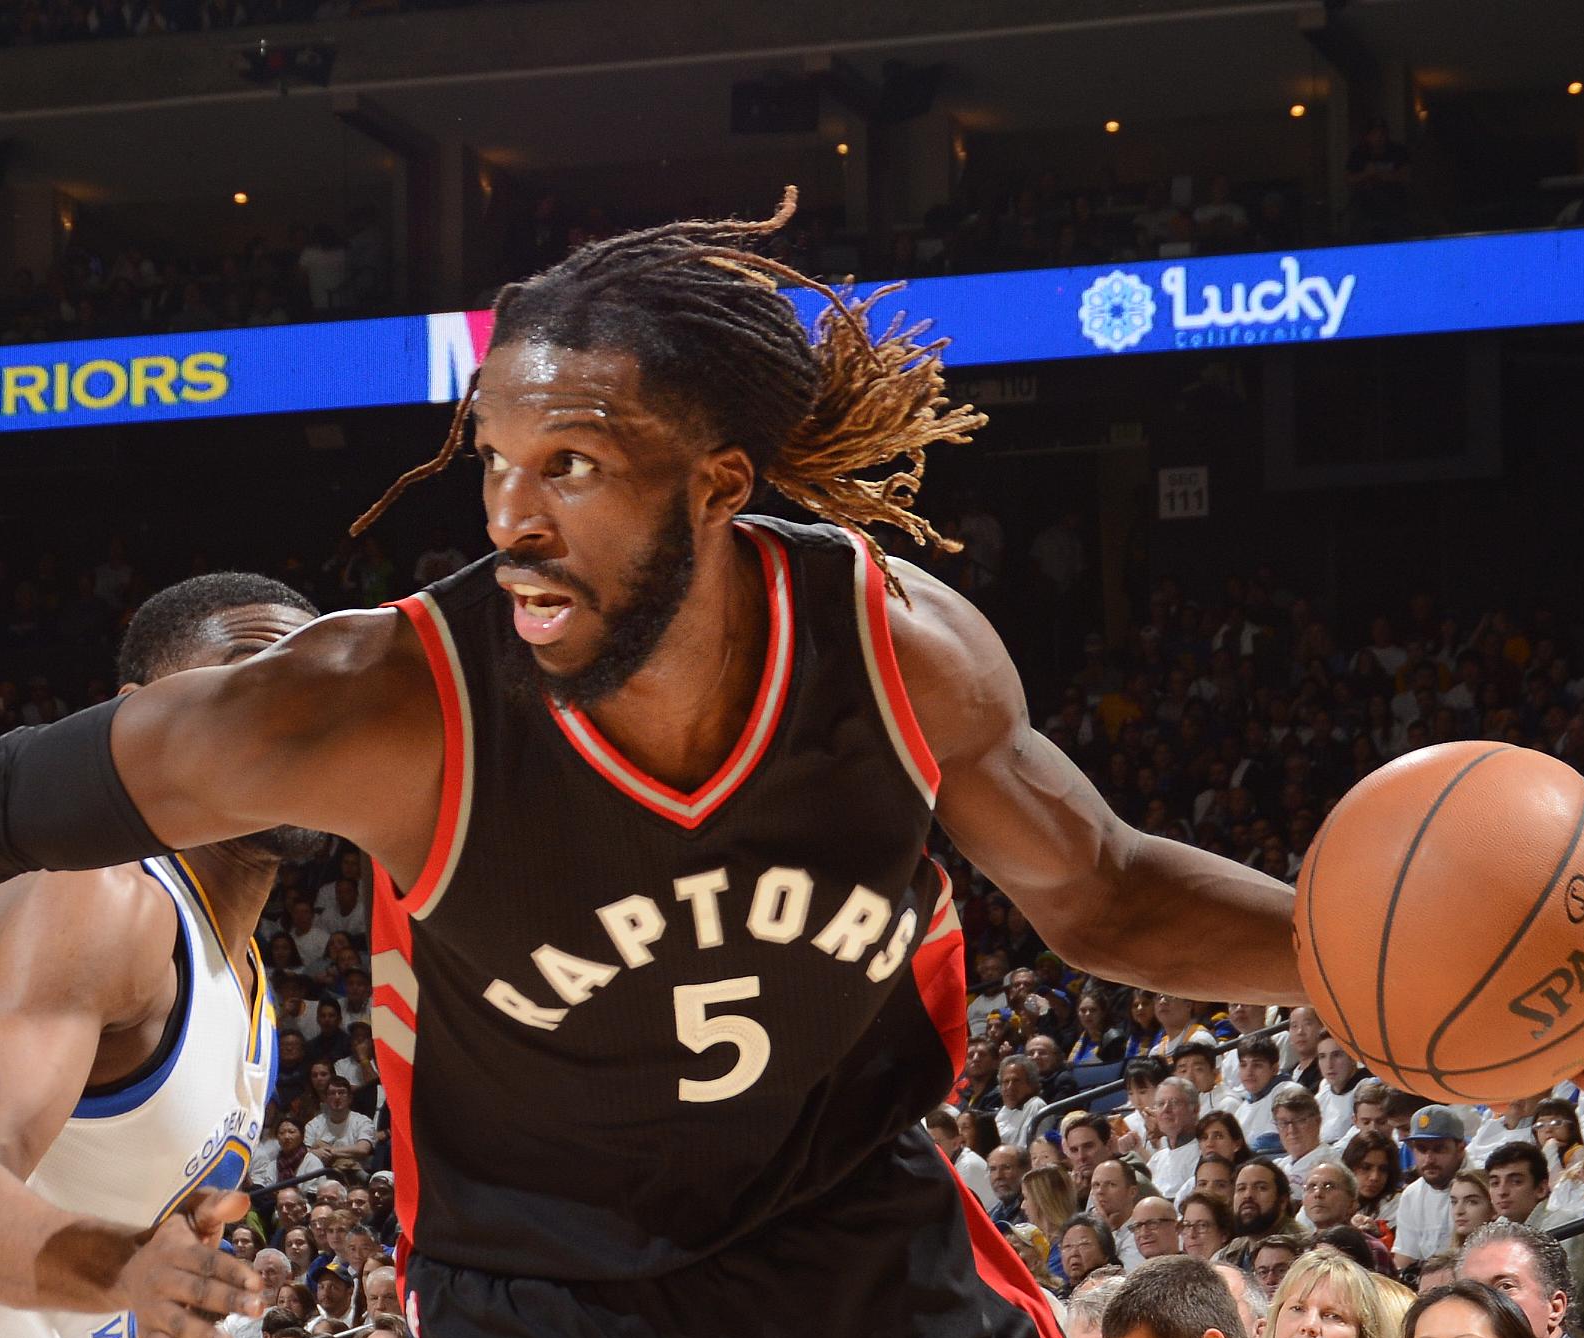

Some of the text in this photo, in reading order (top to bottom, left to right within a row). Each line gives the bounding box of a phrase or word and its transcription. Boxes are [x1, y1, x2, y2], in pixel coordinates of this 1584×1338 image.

[1161, 256, 1356, 338] Lucky
[1174, 324, 1314, 348] California
[482, 866, 917, 1032] RAPTORS
[672, 975, 771, 1103] 5
